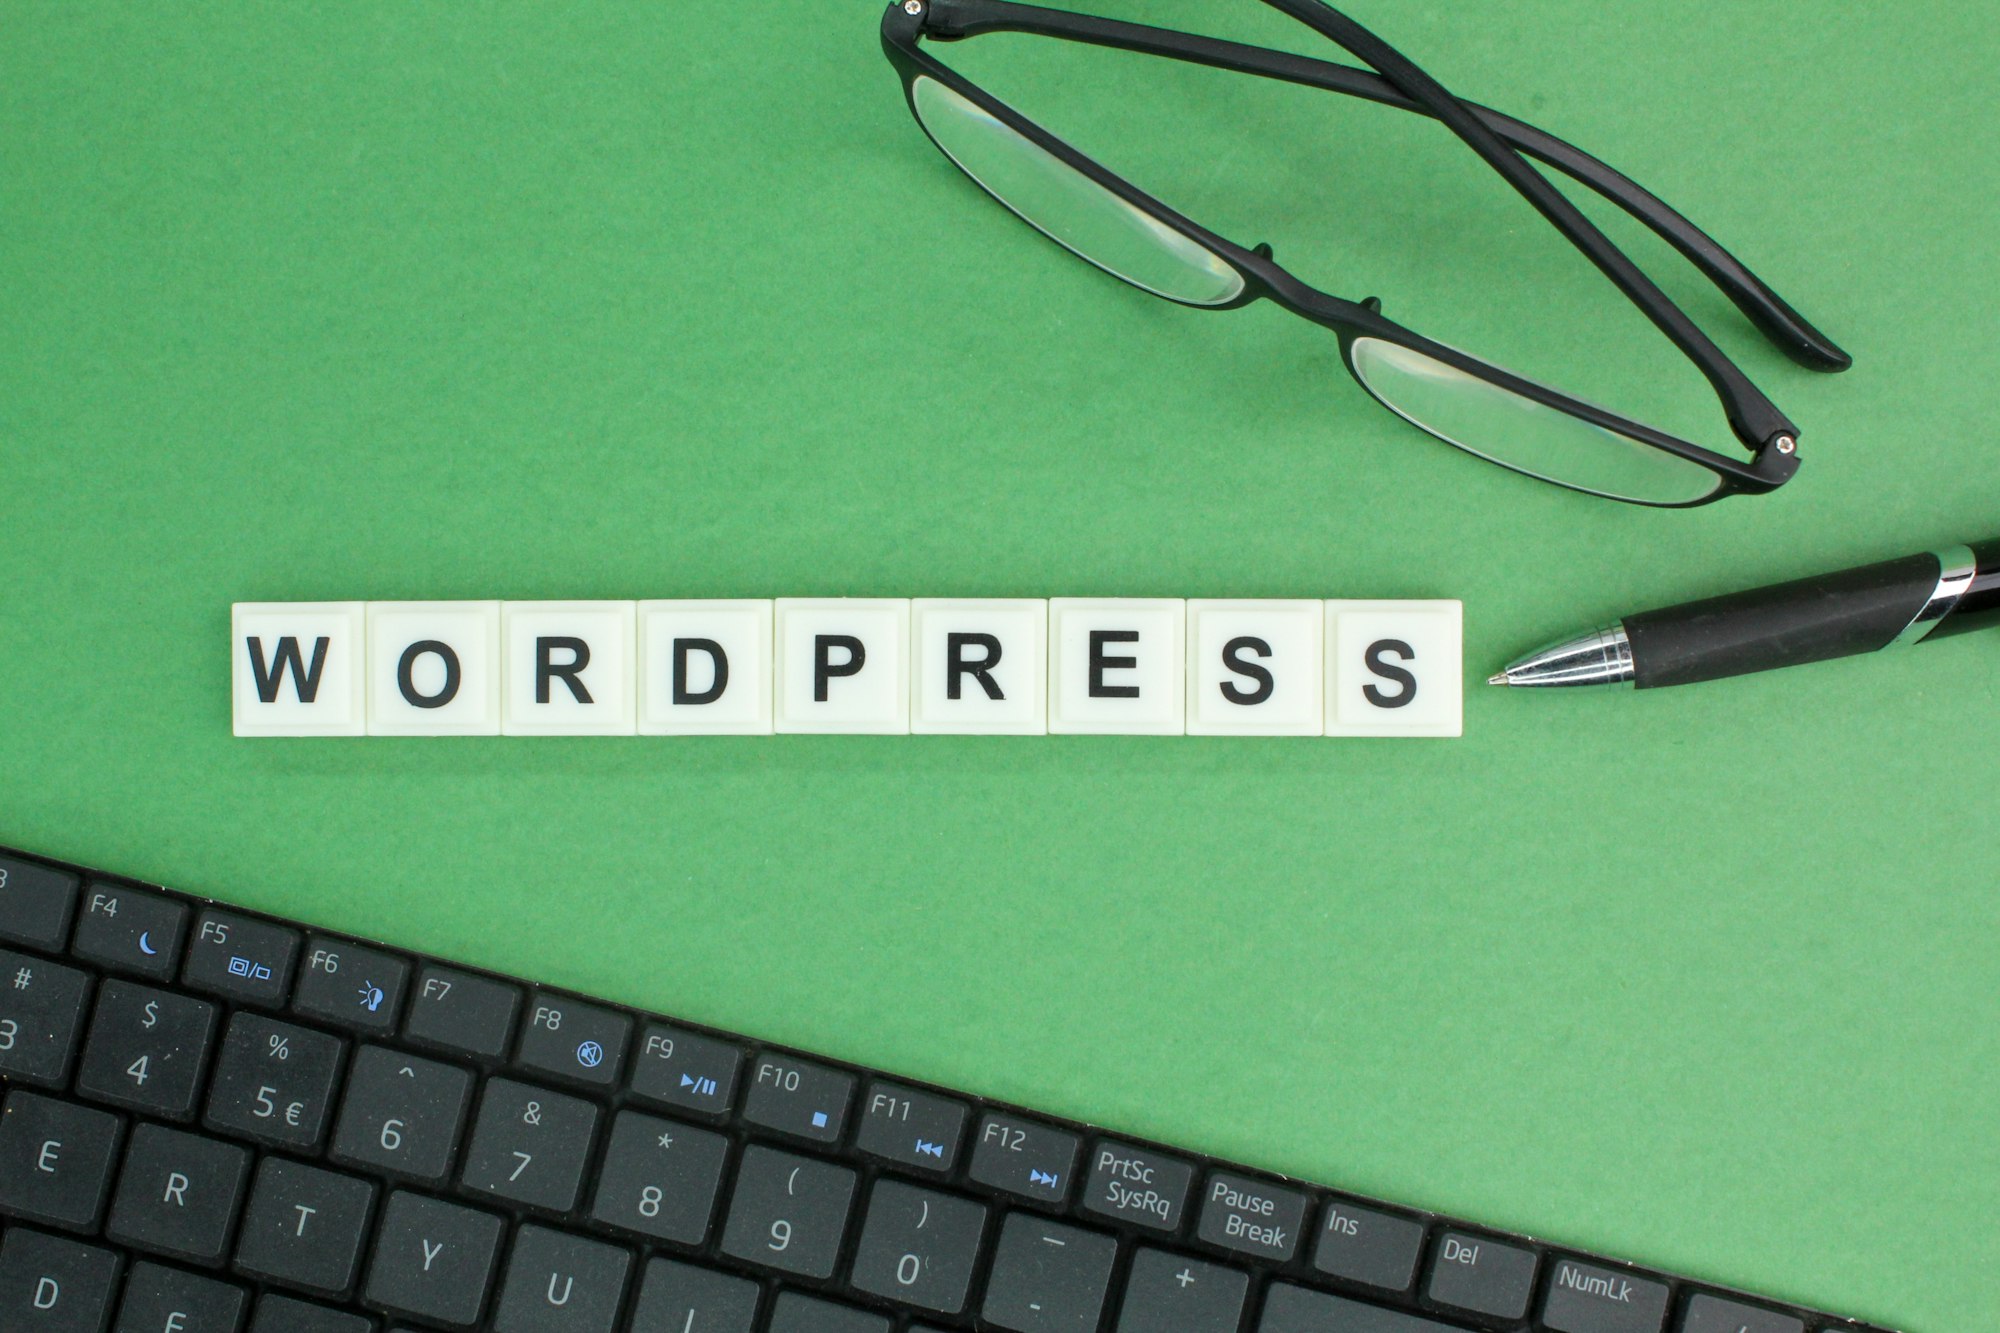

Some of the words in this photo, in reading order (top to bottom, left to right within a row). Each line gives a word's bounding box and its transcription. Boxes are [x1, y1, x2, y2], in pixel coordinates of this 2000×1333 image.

[247, 631, 1416, 708] WORDPRESS
[90, 894, 118, 918] F4
[200, 920, 229, 945] F5
[310, 949, 339, 974] F6
[13, 967, 33, 990] #
[423, 978, 452, 1001] F7
[141, 1000, 159, 1029] $
[533, 1006, 562, 1031] F8
[0, 1019, 18, 1050] 3
[269, 1034, 289, 1060] %
[645, 1035, 674, 1059] F9
[126, 1055, 149, 1086] 4
[757, 1063, 800, 1092] F10
[252, 1085, 277, 1118] 5
[285, 1101, 304, 1126] €
[523, 1101, 542, 1126] &
[871, 1093, 911, 1121] F11
[380, 1119, 404, 1150] 6
[983, 1122, 1026, 1152] F12
[38, 1140, 62, 1173] E
[509, 1151, 532, 1182] 7
[1098, 1151, 1154, 1184] PrtSc
[163, 1172, 189, 1206] R
[638, 1185, 663, 1217] 8
[1105, 1181, 1171, 1221] SysRq
[1211, 1182, 1274, 1217] Pause
[295, 1204, 316, 1237] T
[916, 1200, 928, 1229] )
[1328, 1210, 1359, 1236] Ins
[768, 1219, 792, 1251] 9
[1225, 1214, 1286, 1249] Break
[423, 1238, 443, 1271] Y
[1443, 1239, 1479, 1266] Del
[896, 1254, 920, 1285] 0
[1175, 1268, 1195, 1288] +
[1558, 1265, 1634, 1304] NumLk
[33, 1277, 59, 1309] D
[547, 1272, 573, 1306] U
